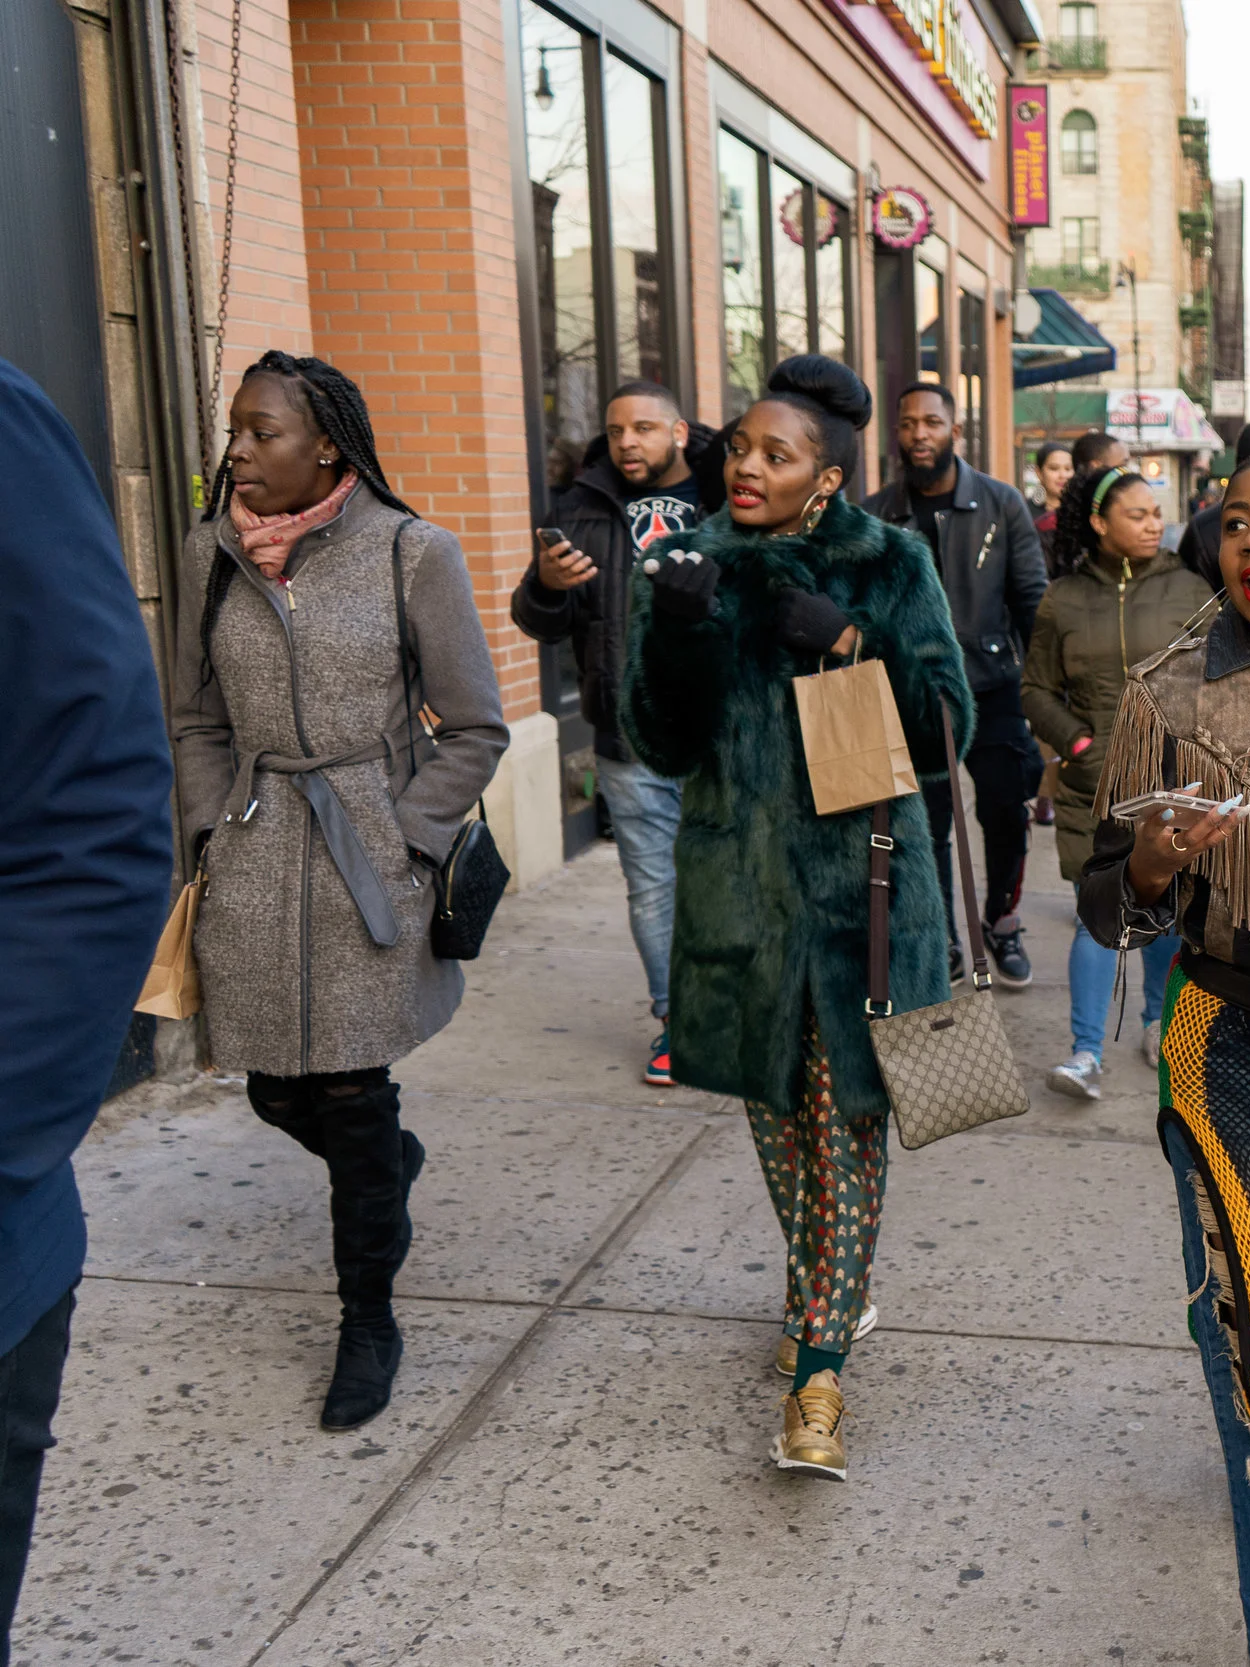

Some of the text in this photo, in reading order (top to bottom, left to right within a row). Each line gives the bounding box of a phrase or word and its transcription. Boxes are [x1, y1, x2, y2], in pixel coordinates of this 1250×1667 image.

[1014, 148, 1028, 217] fitness
[1025, 131, 1046, 199] planet
[626, 500, 685, 518] PARIS
